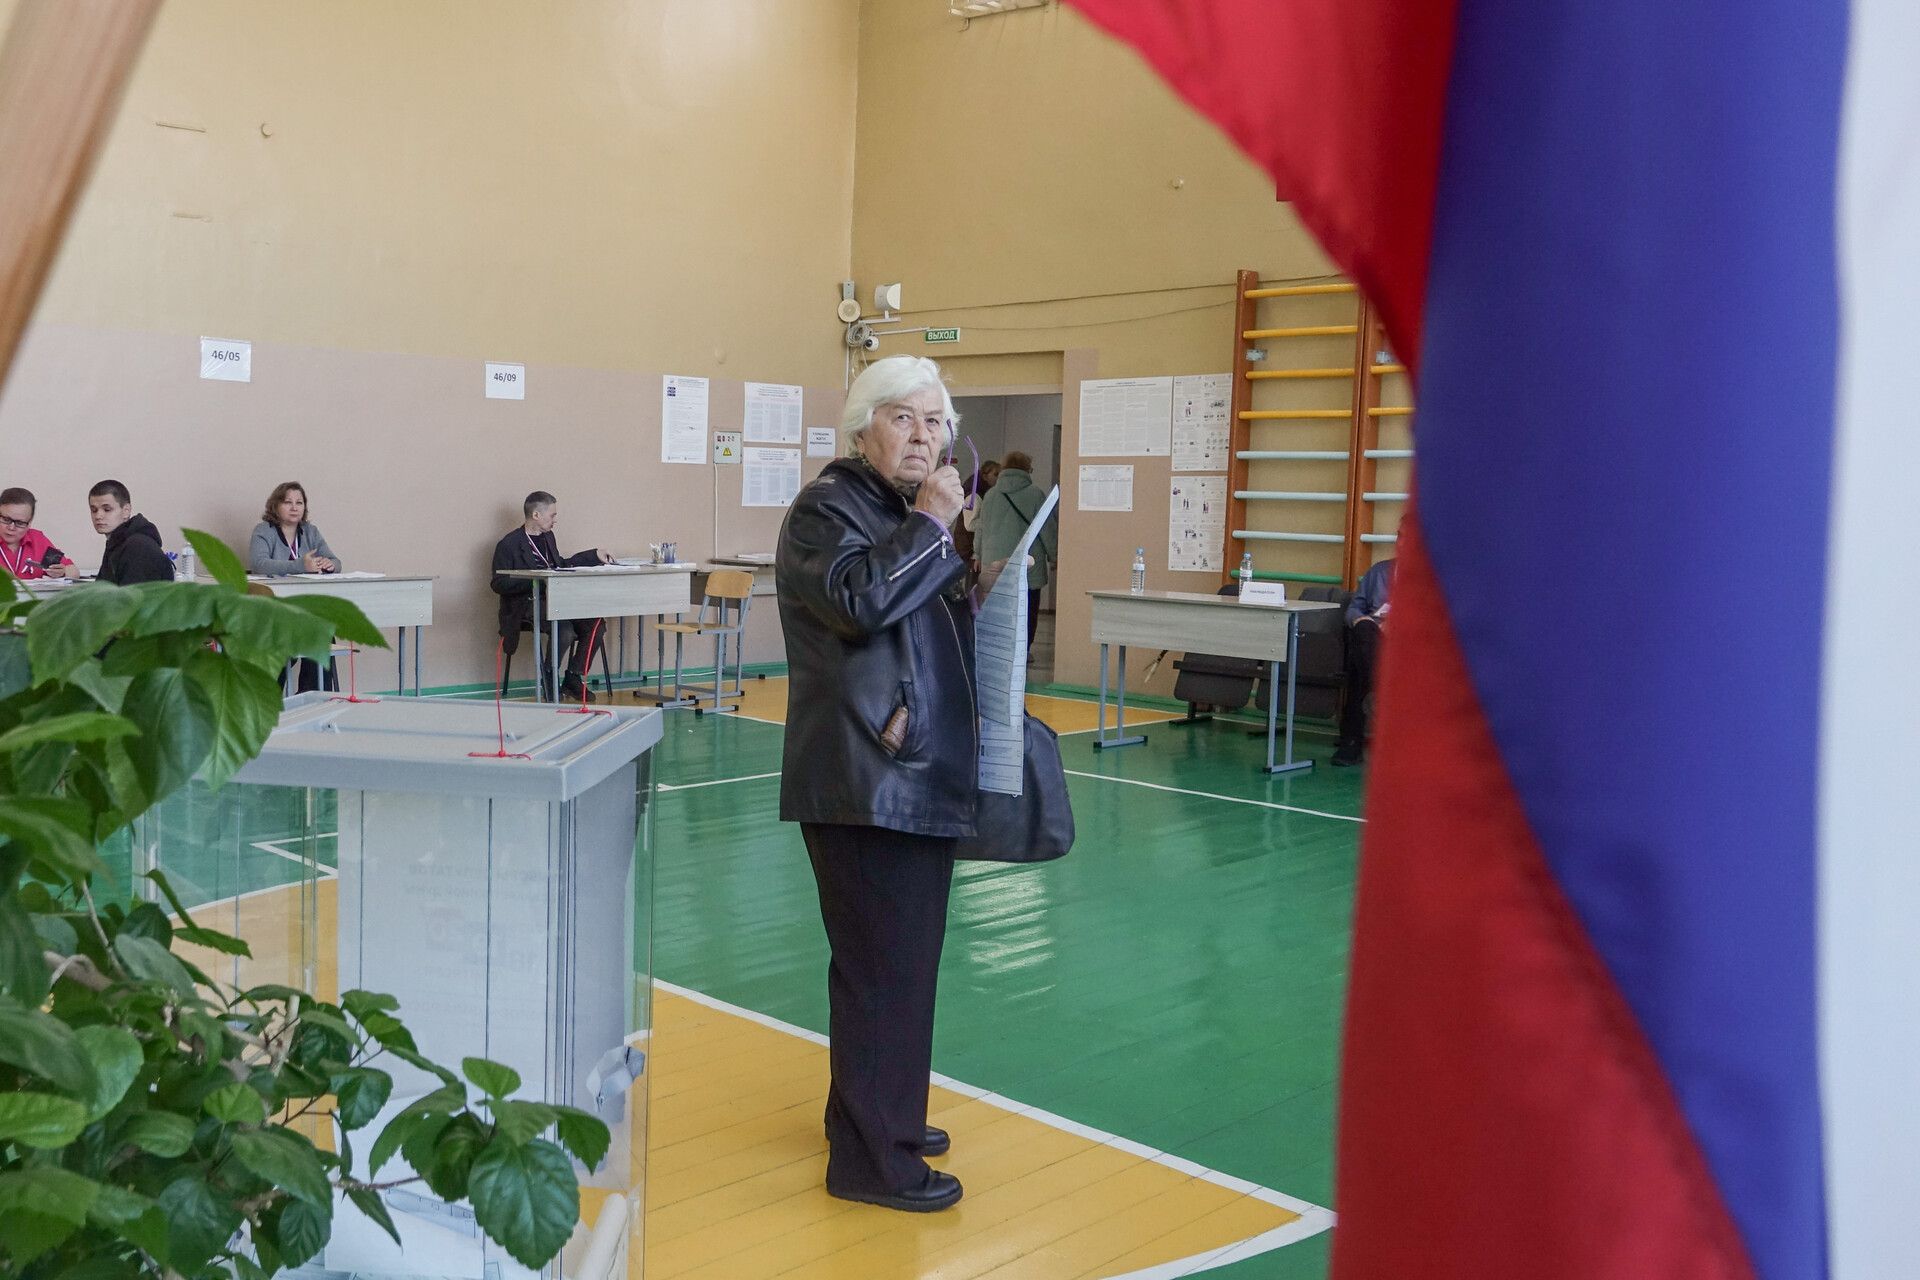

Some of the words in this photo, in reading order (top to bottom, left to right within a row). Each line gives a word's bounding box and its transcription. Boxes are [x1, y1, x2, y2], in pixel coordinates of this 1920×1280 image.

[928, 331, 955, 340] ВЫХОД
[211, 350, 241, 362] 46/05
[494, 372, 517, 382] 46/09
